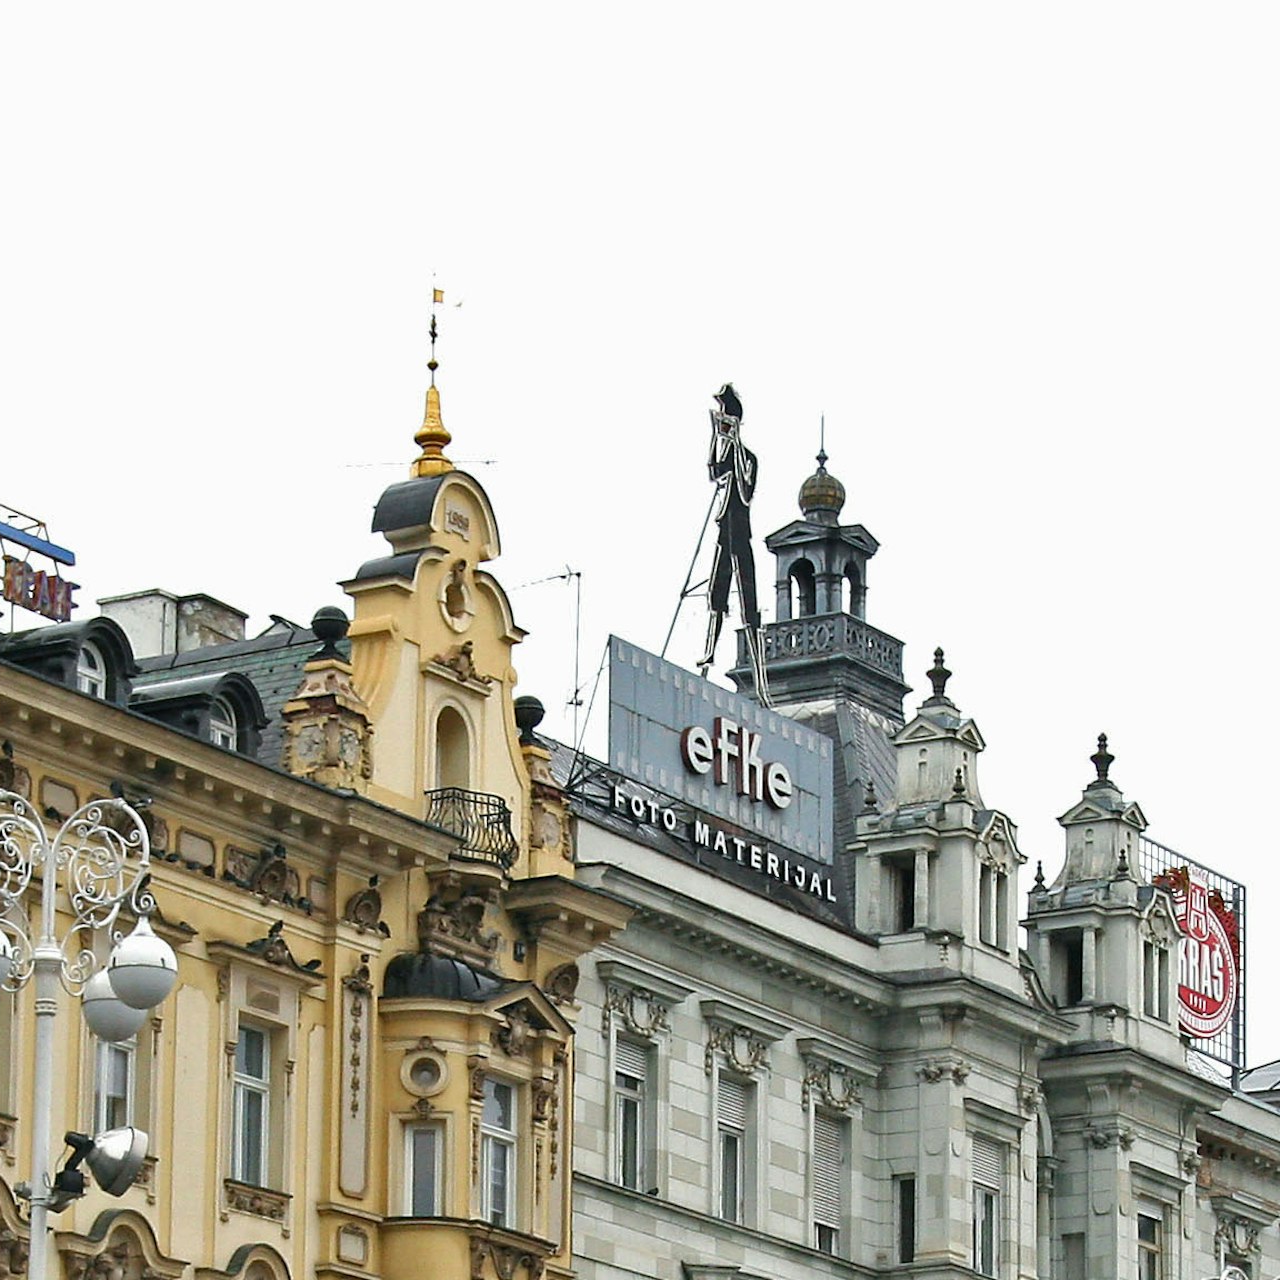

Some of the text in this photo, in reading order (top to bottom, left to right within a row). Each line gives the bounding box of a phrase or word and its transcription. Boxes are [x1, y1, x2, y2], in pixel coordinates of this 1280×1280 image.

[681, 717, 792, 809] efke
[614, 785, 837, 902] FOTO MATERIJAL
